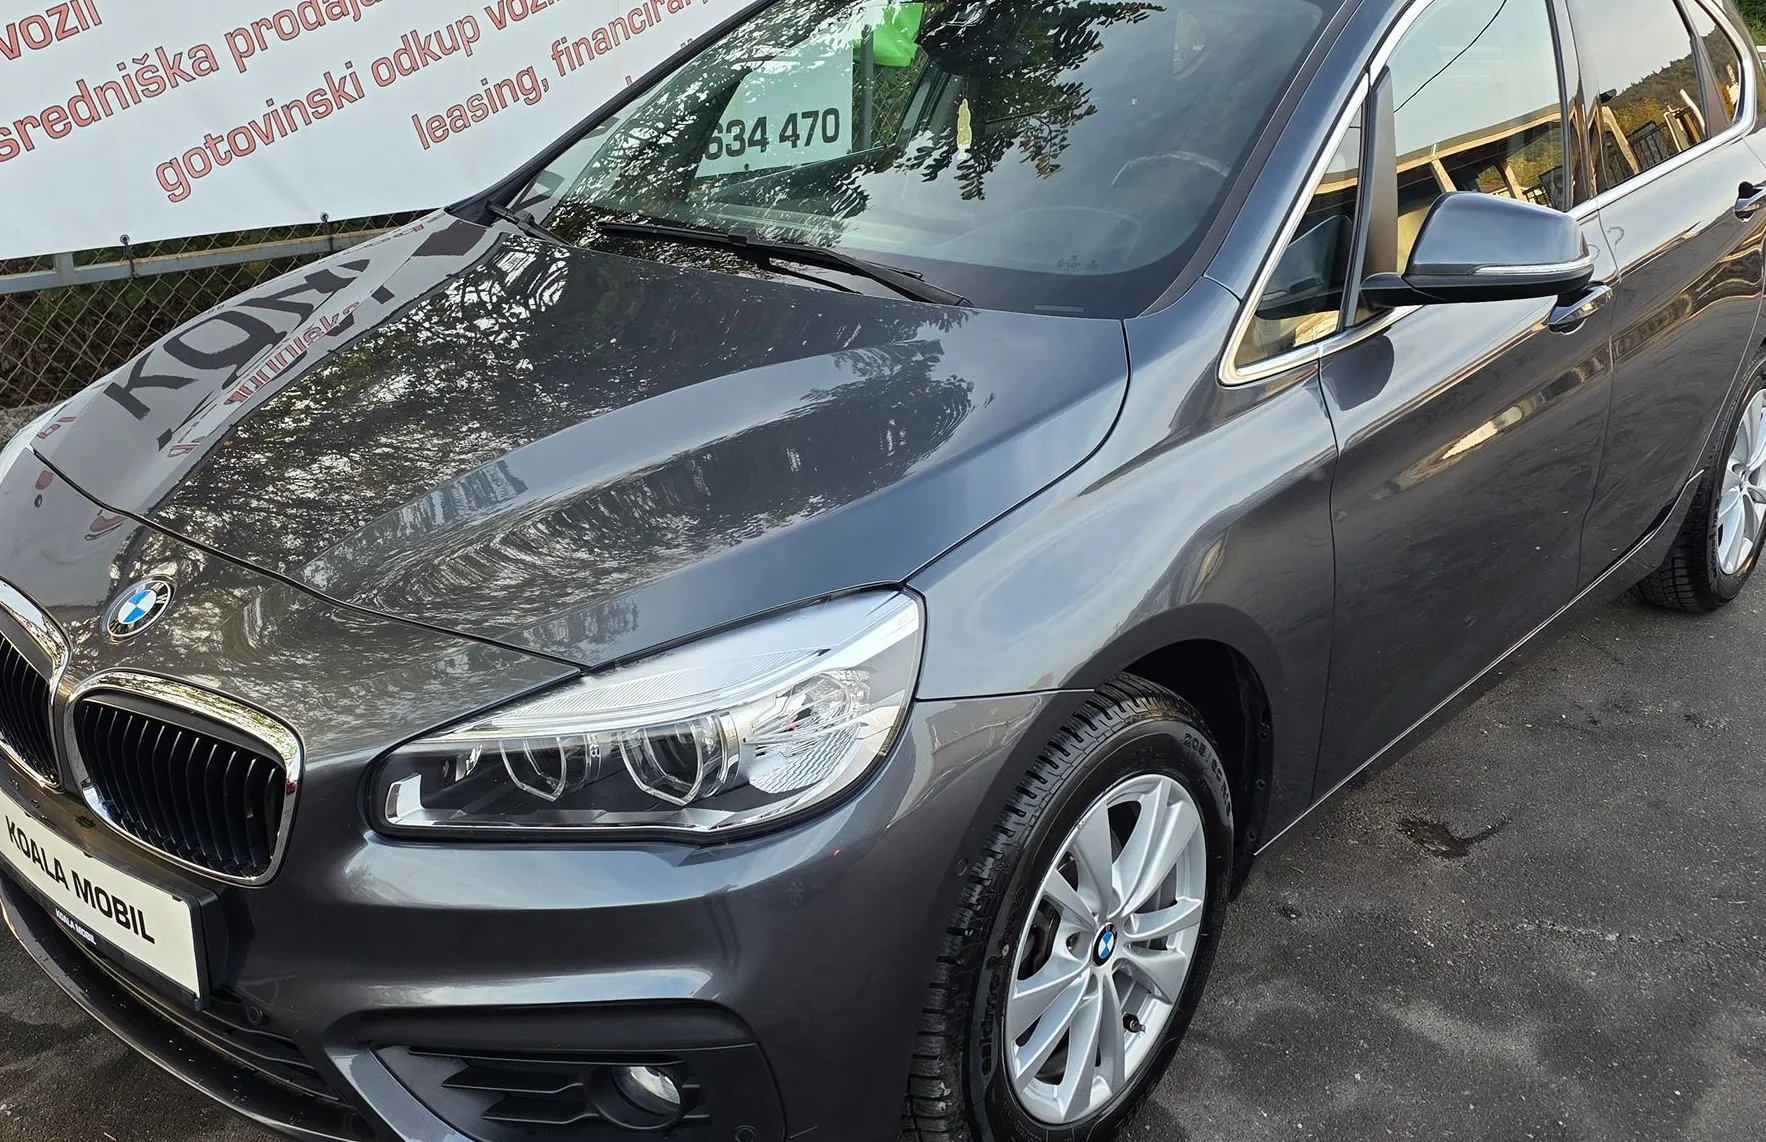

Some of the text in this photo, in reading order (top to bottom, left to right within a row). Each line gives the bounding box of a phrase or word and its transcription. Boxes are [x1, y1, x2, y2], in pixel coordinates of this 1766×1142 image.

[155, 60, 366, 203] gotovinski
[370, 15, 481, 88] odkup
[411, 65, 550, 151] leasing,
[778, 107, 840, 149] 470
[5, 815, 156, 945] KOALA MOBIL
